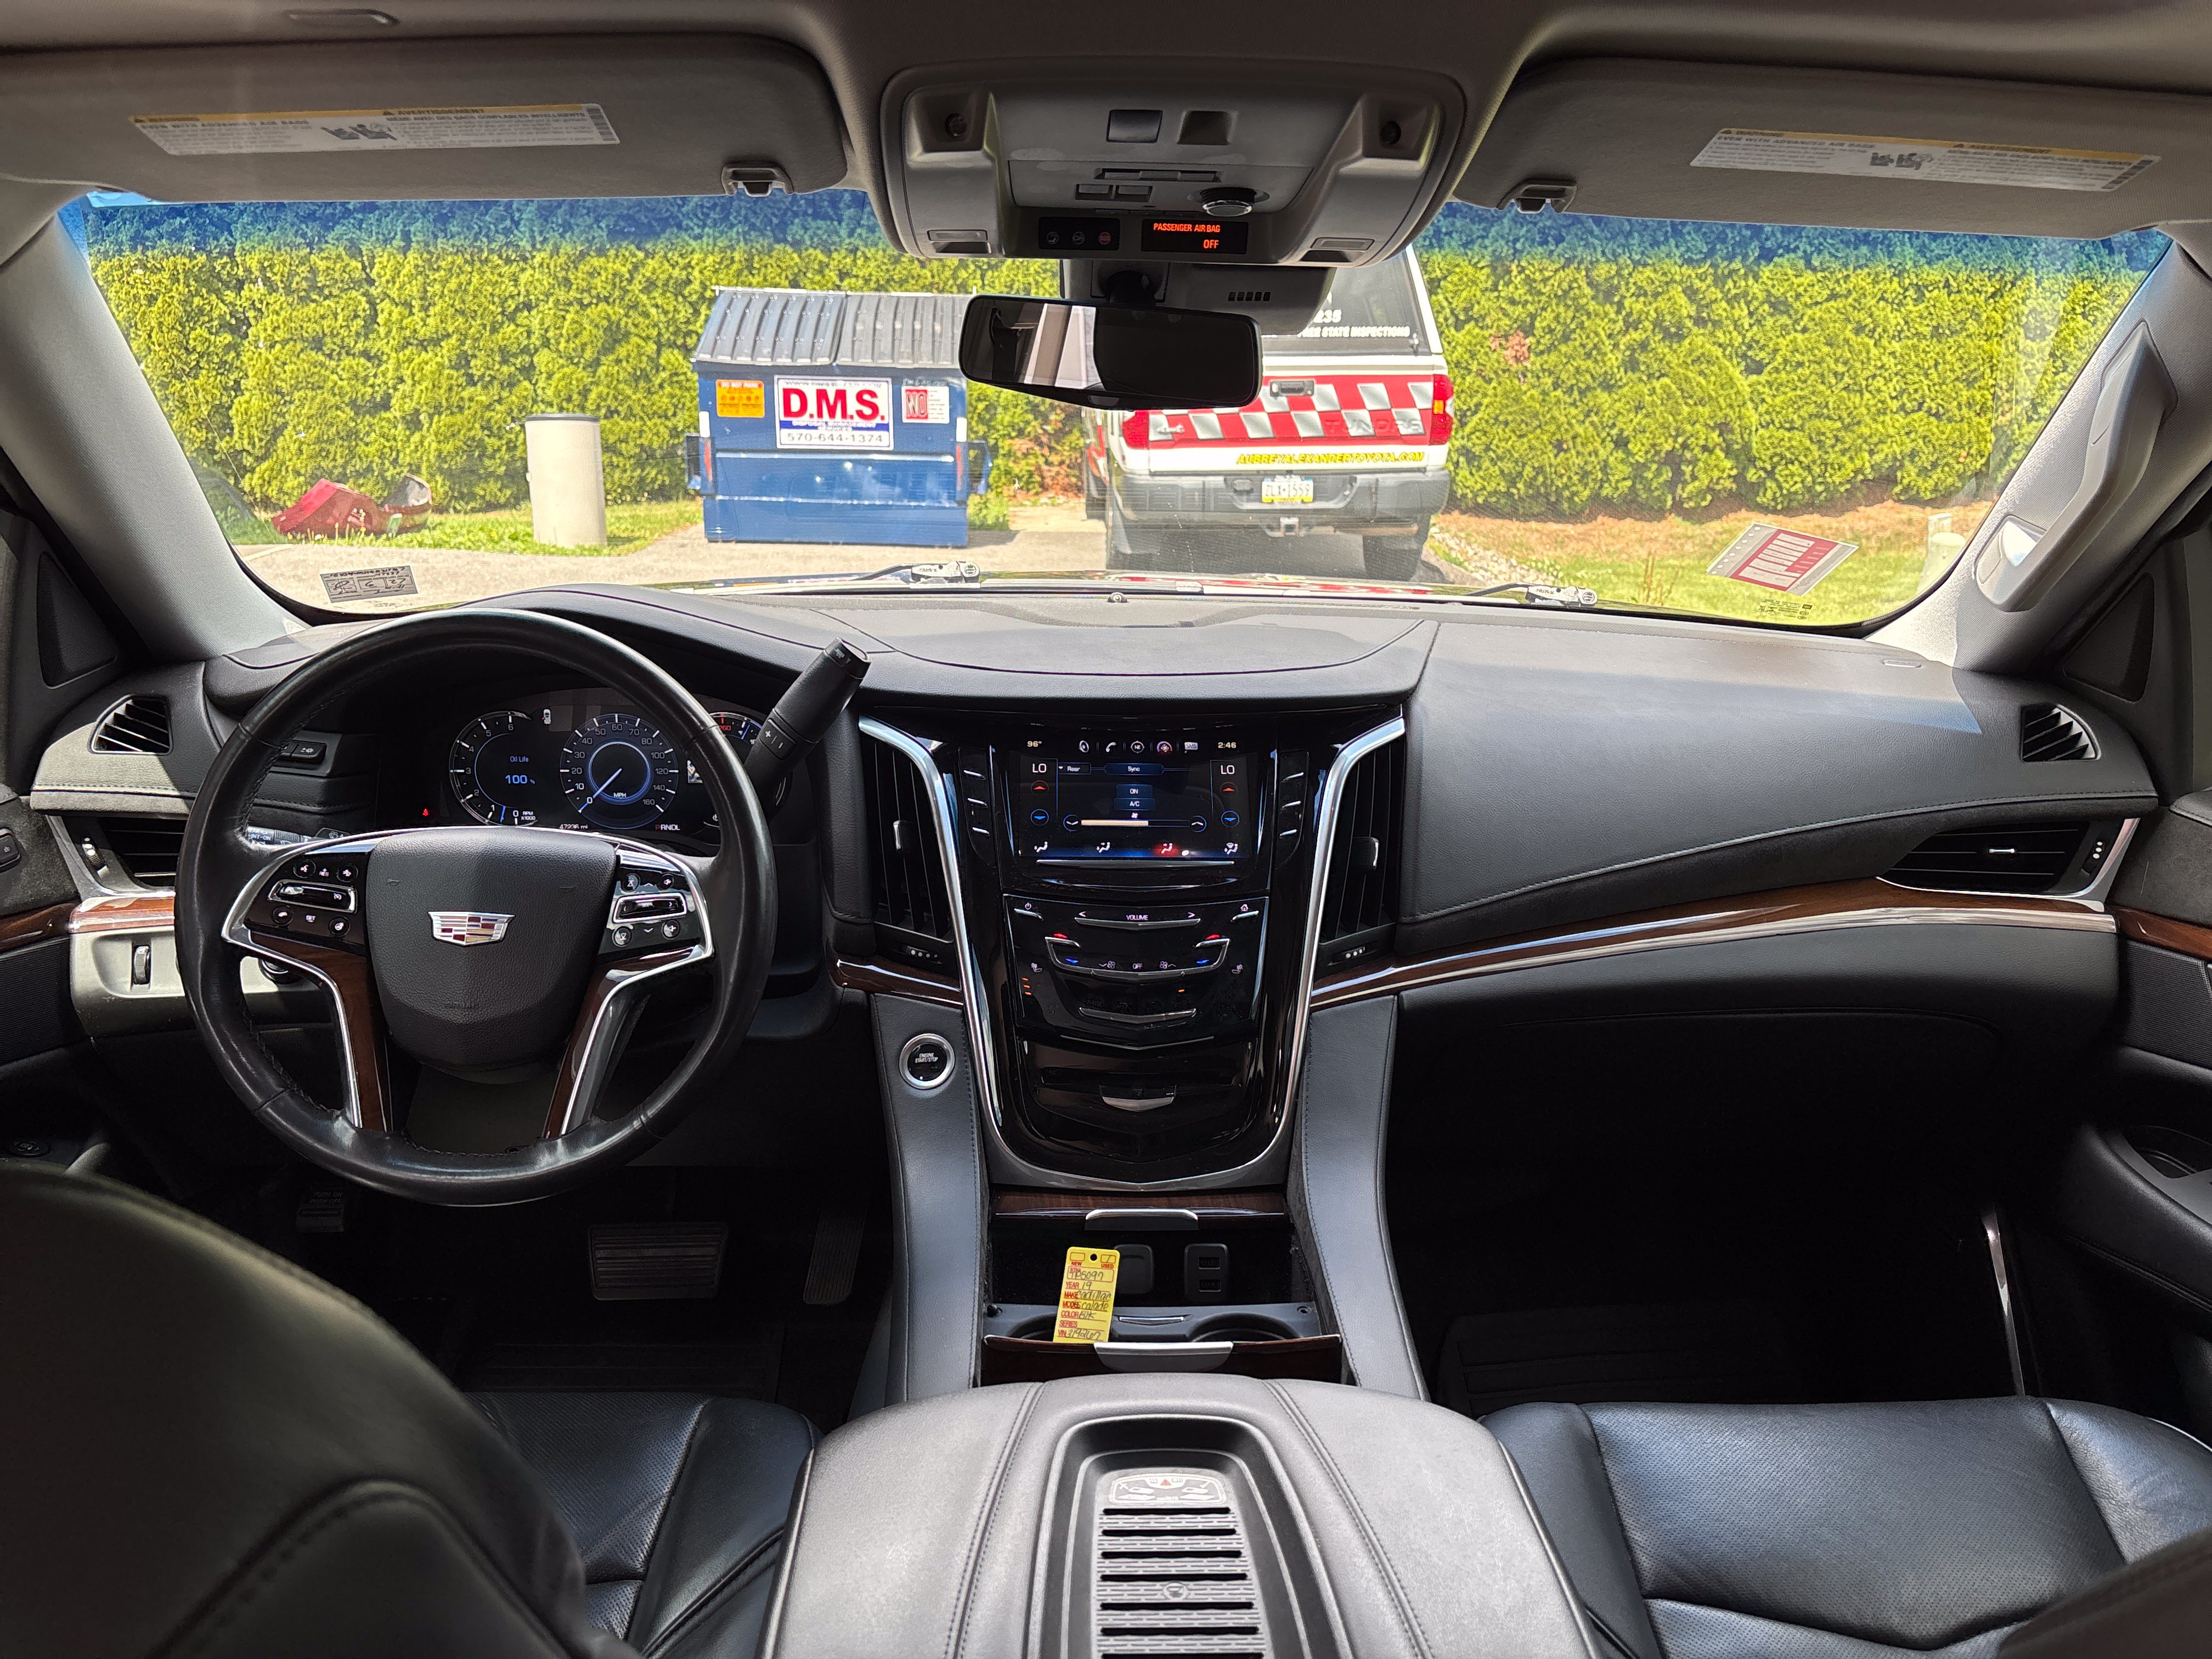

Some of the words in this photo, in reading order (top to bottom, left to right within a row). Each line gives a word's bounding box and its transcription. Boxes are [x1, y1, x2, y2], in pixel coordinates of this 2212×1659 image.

[1153, 223, 1192, 232] PASSENGER
[1194, 224, 1206, 232] AIR
[1206, 224, 1221, 233] BAG
[1203, 239, 1218, 249] OFF
[1297, 326, 1321, 338] REE
[1322, 326, 1350, 337] STATE
[1351, 326, 1410, 337] INSPECTIONS
[782, 388, 885, 421] D.M.S.
[906, 391, 927, 416] NO
[787, 433, 883, 443] 570-644-1374
[1236, 451, 1425, 465] AUBREYALEXANDERTOYOTA.COM
[1032, 764, 1047, 773] LO
[1221, 765, 1235, 774] LO
[505, 775, 528, 784] 100
[1082, 1282, 1092, 1290] 19
